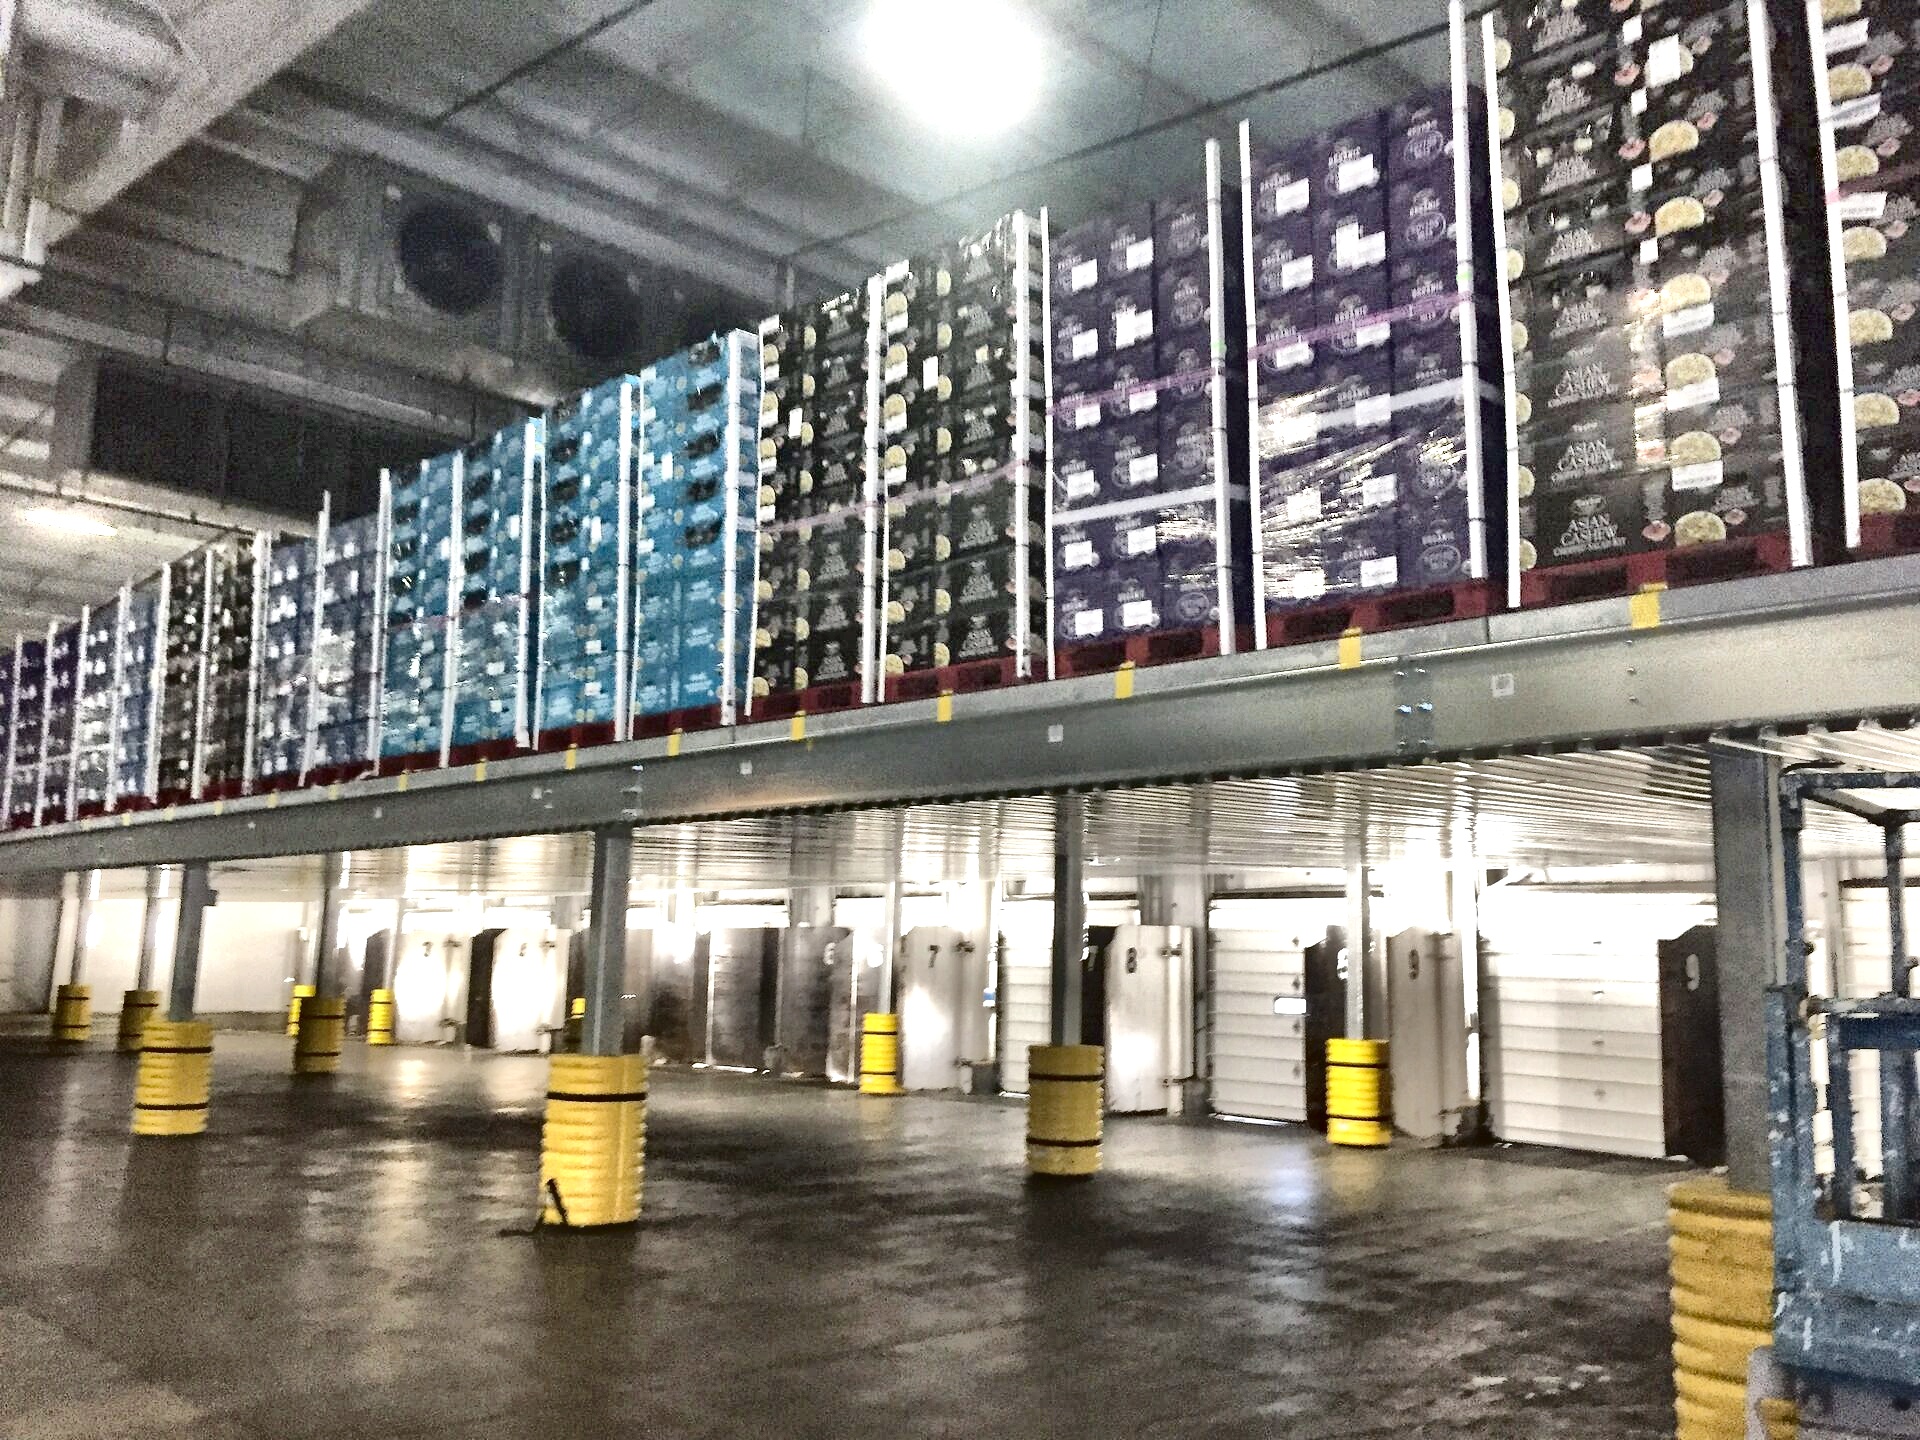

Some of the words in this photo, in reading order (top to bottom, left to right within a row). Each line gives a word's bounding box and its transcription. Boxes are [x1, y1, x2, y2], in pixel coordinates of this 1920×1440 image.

[1561, 524, 1618, 546] CASHEW
[1568, 513, 1610, 533] ASIAN
[929, 945, 939, 968] 7
[1125, 947, 1137, 974] 8
[1408, 949, 1420, 980] 9
[1685, 953, 1700, 992] 9
